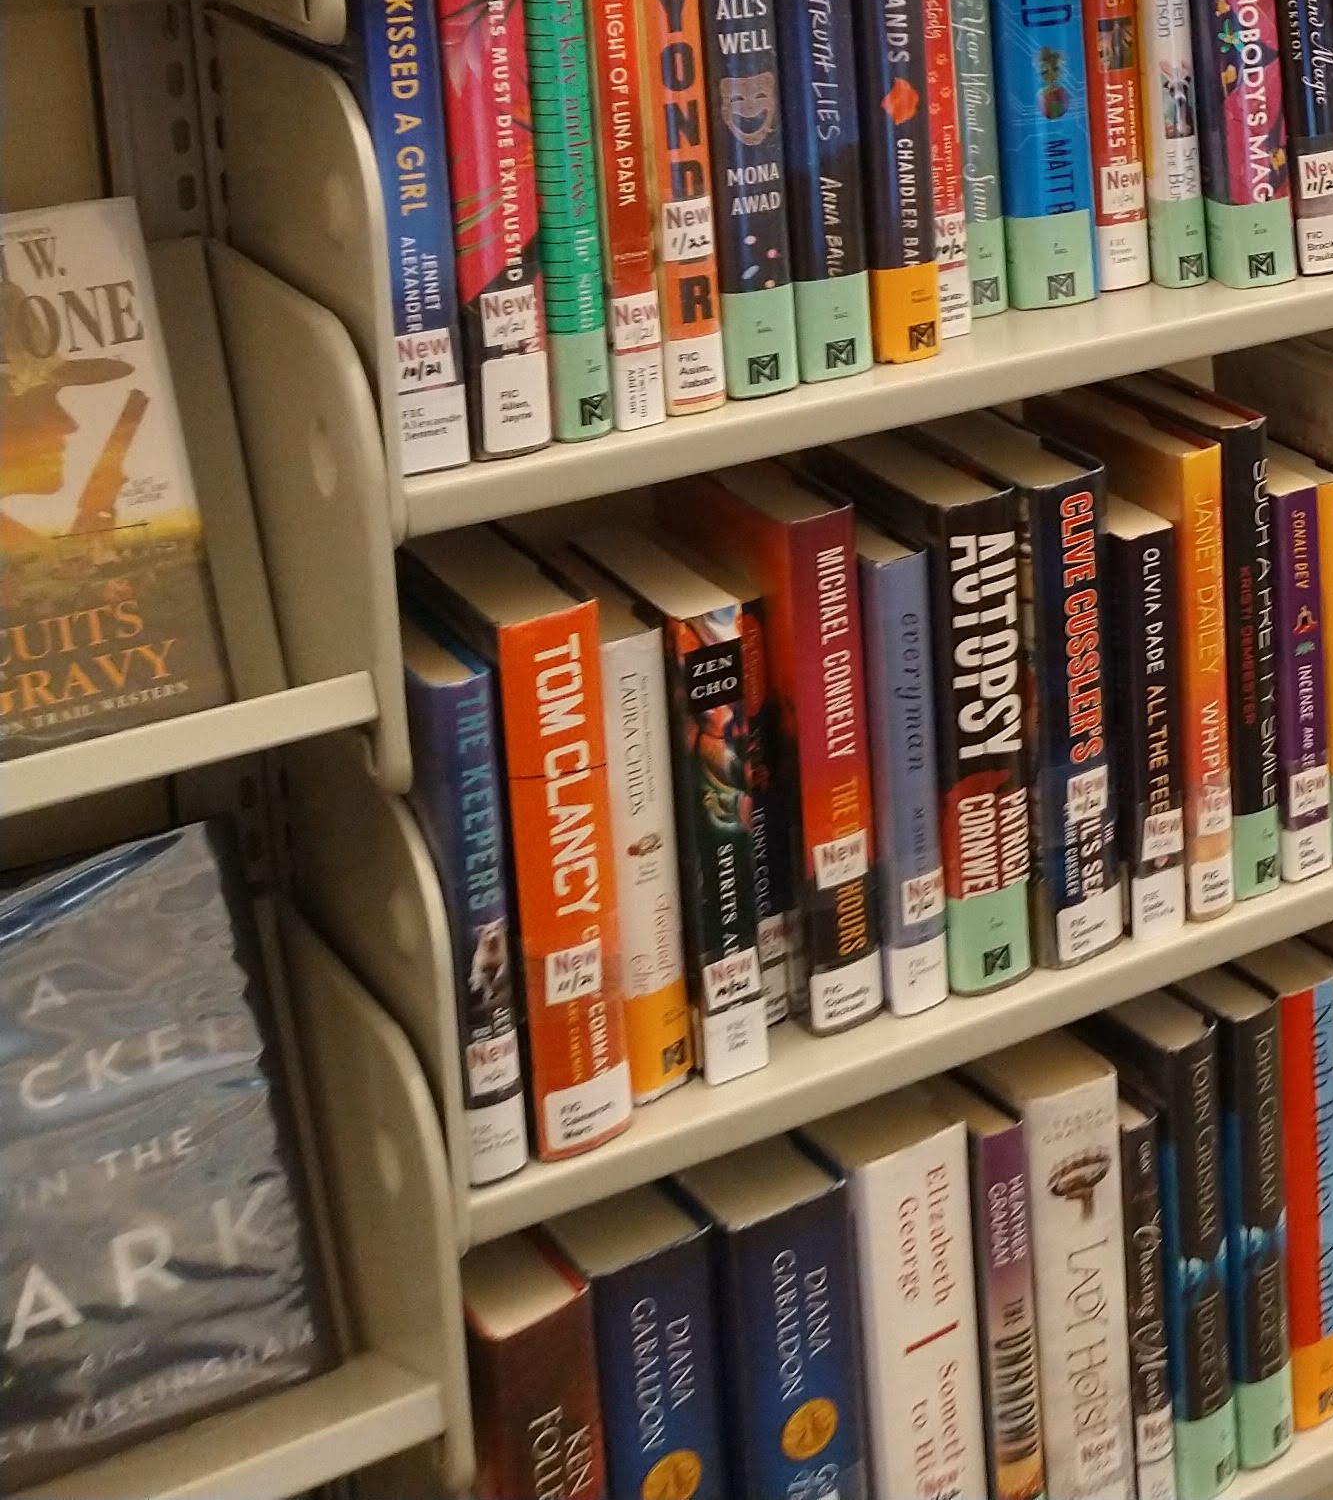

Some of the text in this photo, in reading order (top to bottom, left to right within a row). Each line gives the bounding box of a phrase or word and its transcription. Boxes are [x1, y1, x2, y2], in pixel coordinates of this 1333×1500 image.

[604, 3, 626, 60] LIGHT
[718, 32, 773, 56] WELL
[491, 47, 512, 103] MUST
[610, 67, 629, 97] OF
[393, 113, 422, 134] A
[496, 114, 515, 148] DIE
[611, 101, 633, 154] LUNA
[811, 76, 841, 143] LIES
[396, 146, 428, 216] GIRL
[616, 157, 637, 207] PARK
[727, 162, 779, 186] MONA
[897, 138, 919, 230] CHANDLER
[500, 158, 523, 282] EXHAUSTED
[731, 191, 781, 217] AWAD
[19, 235, 68, 279] W.
[401, 236, 423, 332] ALEXANDER
[421, 253, 441, 310] JENNET
[397, 338, 448, 362] New
[692, 653, 735, 678] ZEN
[816, 546, 857, 760] MICHAEL CONNELLY
[949, 530, 1023, 760] AUTOPSY
[690, 676, 738, 701] CHO
[1063, 589, 1104, 764] CUSSLER'S
[533, 632, 600, 920] TOM CLANCY
[1254, 1025, 1278, 1210] JOHN GRISHAM
[899, 1196, 922, 1301] George
[927, 1163, 959, 1306] Elizabeth
[771, 1248, 805, 1402] GABALDON
[805, 1266, 831, 1359] DIANA
